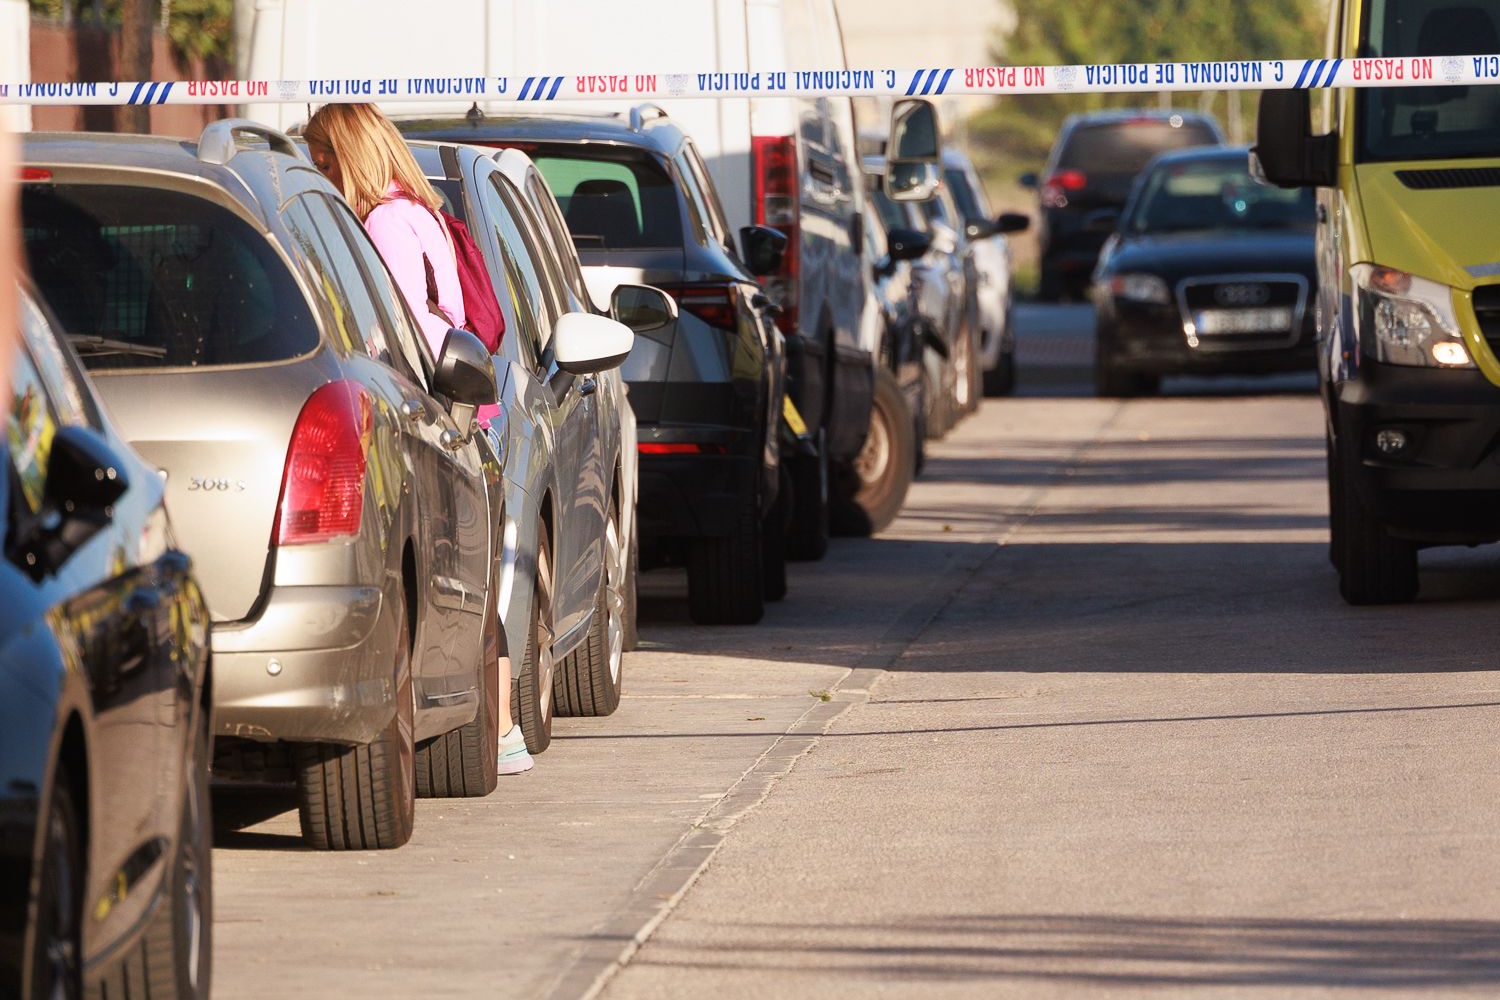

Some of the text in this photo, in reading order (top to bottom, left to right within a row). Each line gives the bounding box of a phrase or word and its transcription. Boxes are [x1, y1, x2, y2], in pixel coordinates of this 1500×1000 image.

[965, 66, 1046, 89] NO PASAR
[1085, 65, 1149, 85] POLICIA
[1155, 64, 1175, 84] DE
[1182, 62, 1262, 84] NACIONAL
[1352, 58, 1433, 81] NO PASAR
[187, 80, 269, 97] NO PASAR
[498, 77, 507, 94] C
[576, 75, 657, 94] NO PASAR
[698, 73, 760, 91] POLICIA
[767, 72, 787, 90] DE
[795, 71, 874, 89] NACIONAL
[109, 83, 118, 97] C
[187, 476, 229, 492] 308
